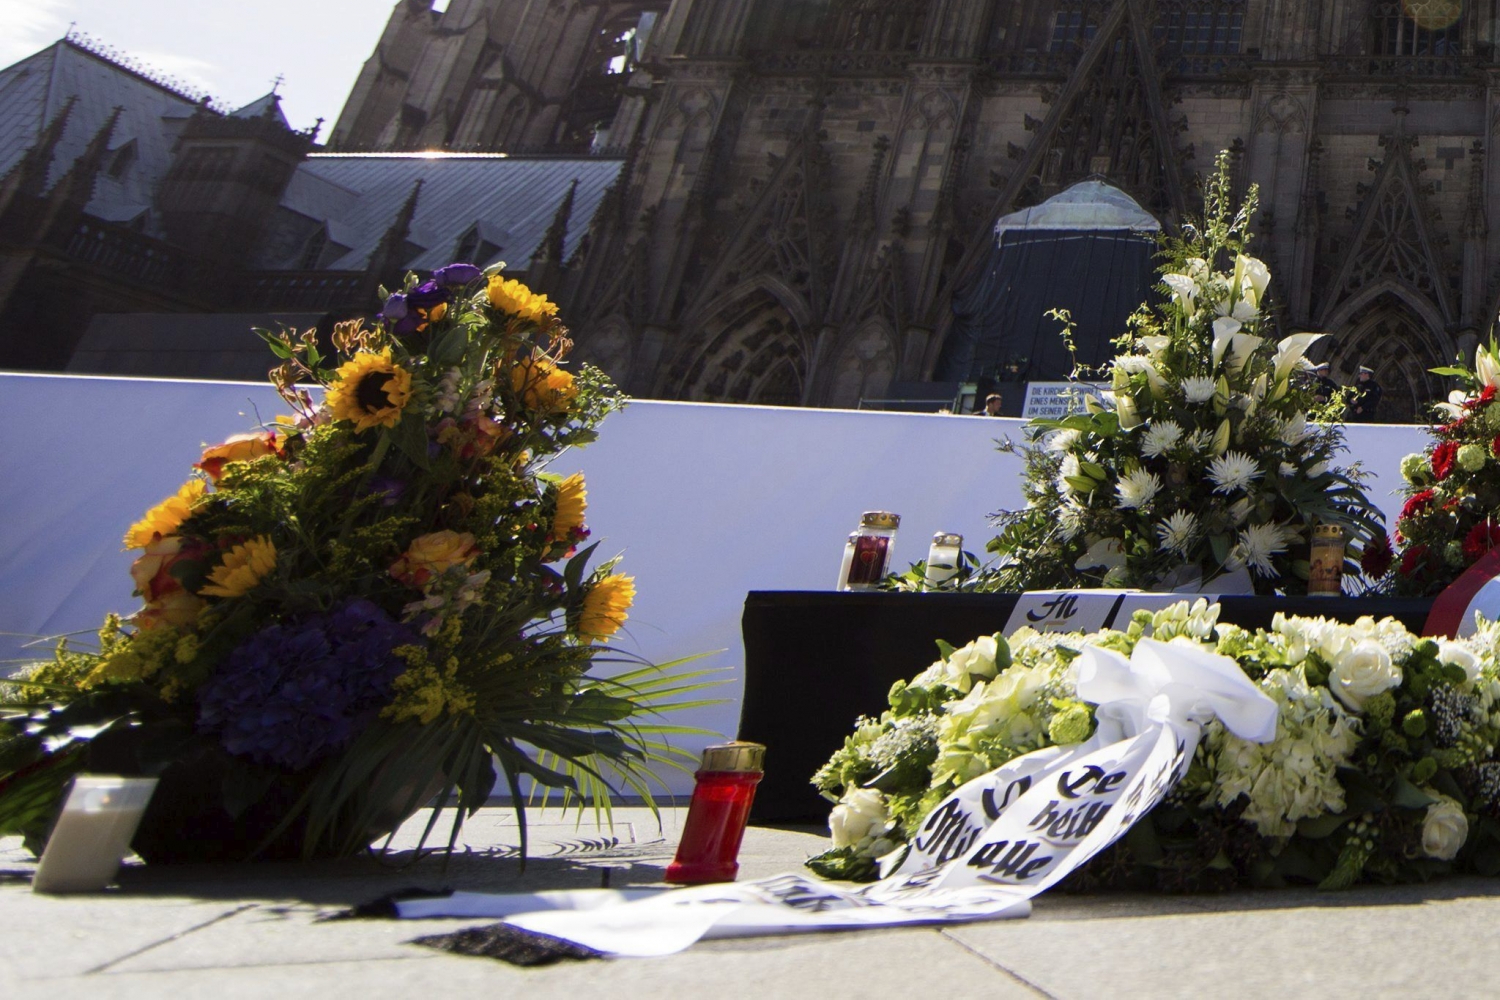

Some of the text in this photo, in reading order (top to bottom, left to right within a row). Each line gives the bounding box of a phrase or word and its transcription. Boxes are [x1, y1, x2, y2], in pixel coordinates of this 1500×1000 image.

[1032, 387, 1042, 396] DIE
[1030, 397, 1049, 406] EINES
[1028, 406, 1085, 416] UM SEINER RSSE
